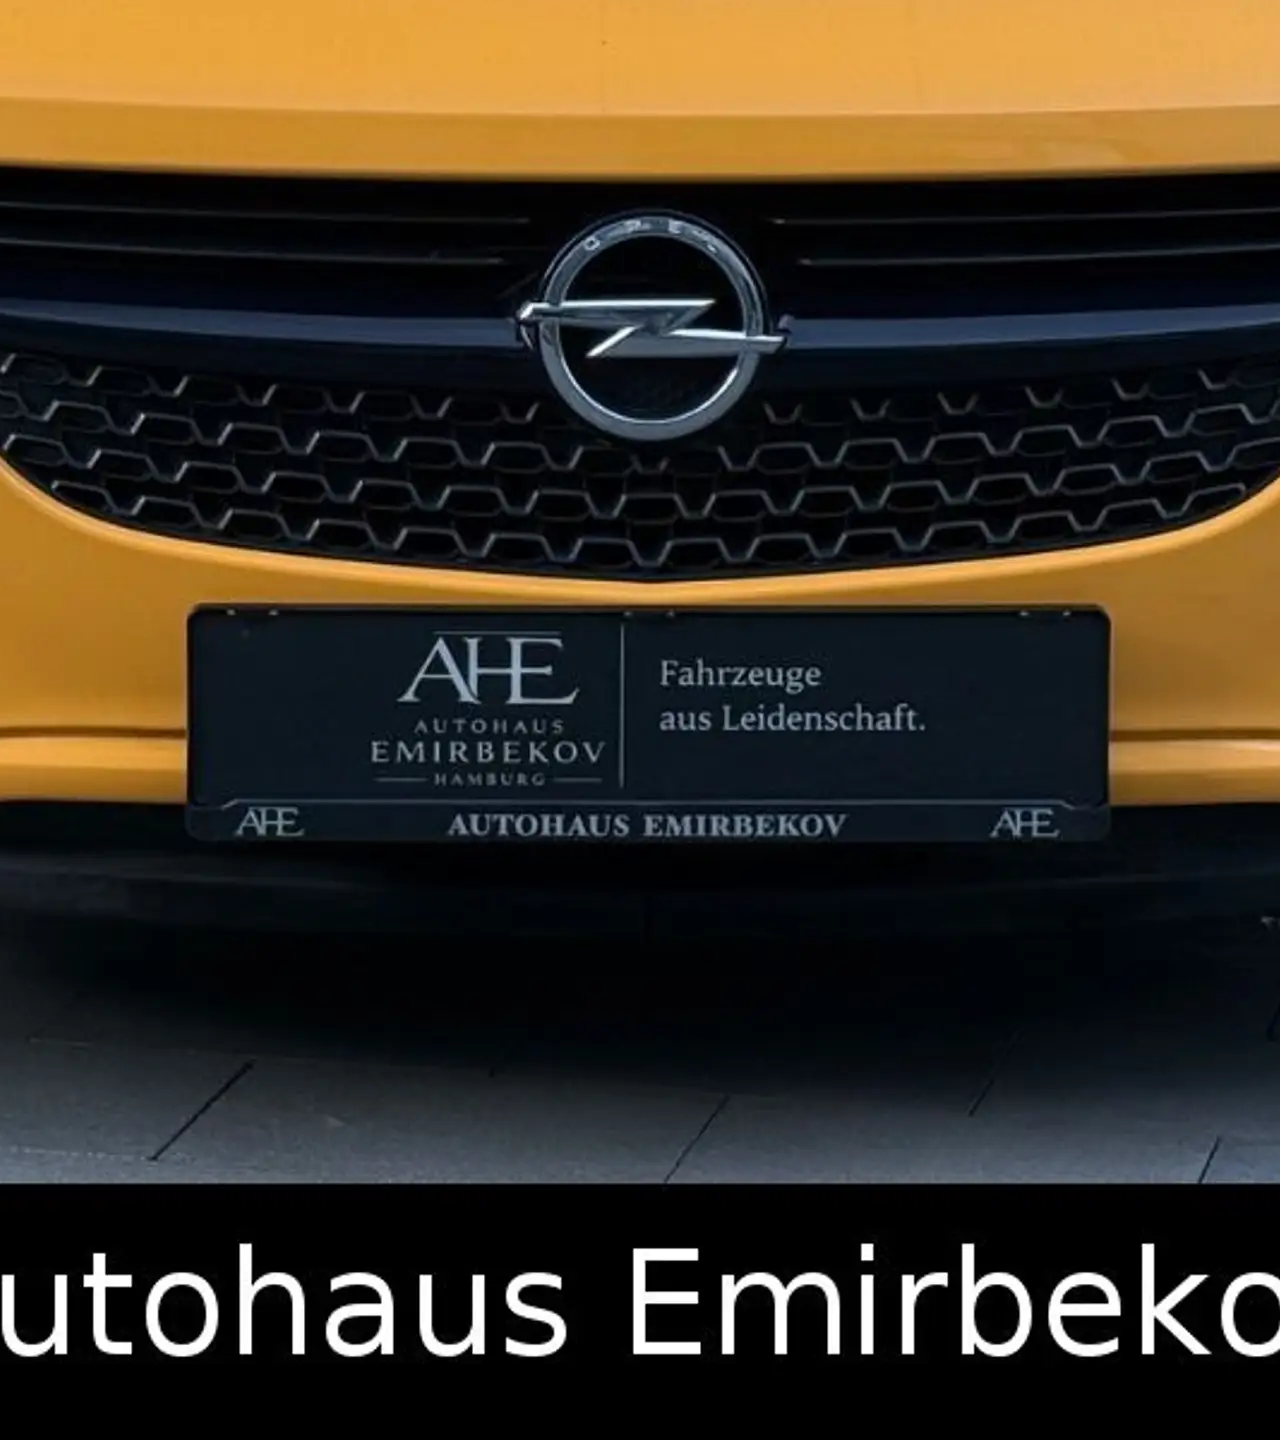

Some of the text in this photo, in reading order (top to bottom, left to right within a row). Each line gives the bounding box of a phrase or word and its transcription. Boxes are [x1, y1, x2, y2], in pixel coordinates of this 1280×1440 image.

[396, 636, 580, 705] AHE
[660, 658, 822, 695] Fahrzeuge
[414, 718, 564, 734] AUTOHAUS
[660, 702, 926, 731] aus Leidenschaft.
[370, 740, 606, 764] EMIRBEKOV
[434, 772, 547, 787] HAMBURG
[234, 806, 305, 837] AHE
[447, 813, 847, 838] AUTOHAUS EMIRBEKOV
[989, 807, 1060, 837] AHE
